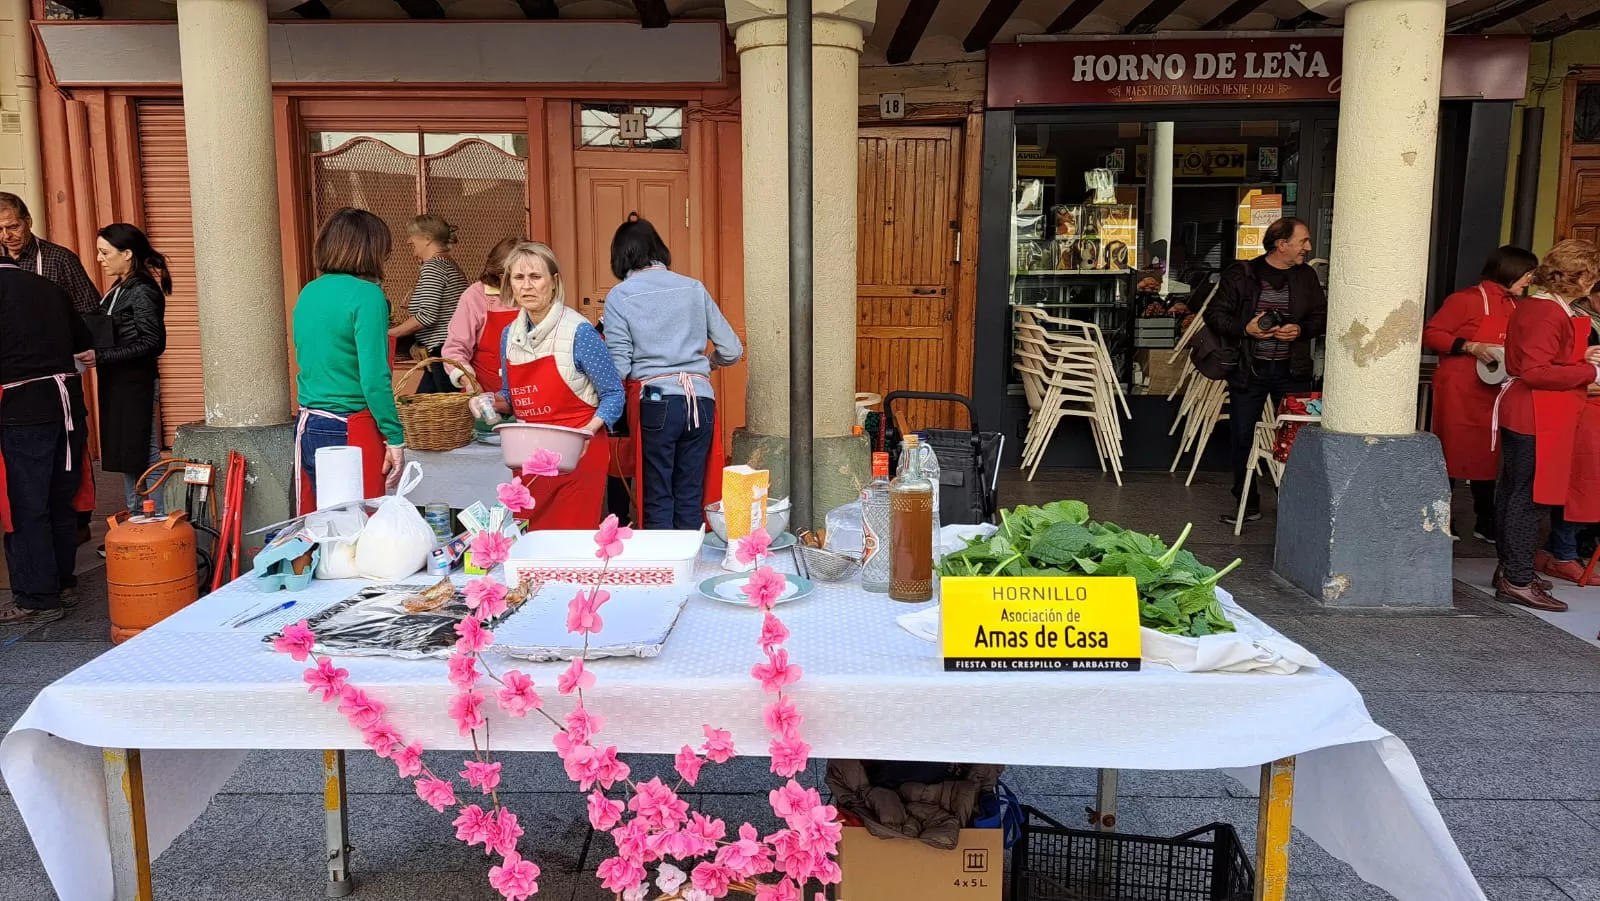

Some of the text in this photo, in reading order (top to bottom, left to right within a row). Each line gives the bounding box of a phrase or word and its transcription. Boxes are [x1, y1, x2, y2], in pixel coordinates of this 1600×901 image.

[1072, 43, 1330, 82] HORNO DE LEÑA
[1125, 82, 1274, 97] MAESTROS PANADEROS DESDE 1929
[885, 99, 900, 114] 18
[625, 119, 639, 133] 17
[511, 385, 538, 395] IESTA
[514, 397, 534, 406] DEL
[992, 586, 1088, 601] HORNILLO
[1000, 607, 1081, 623] Asociación de
[974, 624, 1109, 648] Amas de Casa
[955, 660, 987, 669] FIESTA
[990, 660, 1009, 669] DEL
[1011, 660, 1062, 669] CRESPILLO
[1072, 660, 1129, 669] BARBASTRO
[954, 879, 960, 887] 4
[971, 879, 977, 887] 5
[980, 879, 988, 887] L
